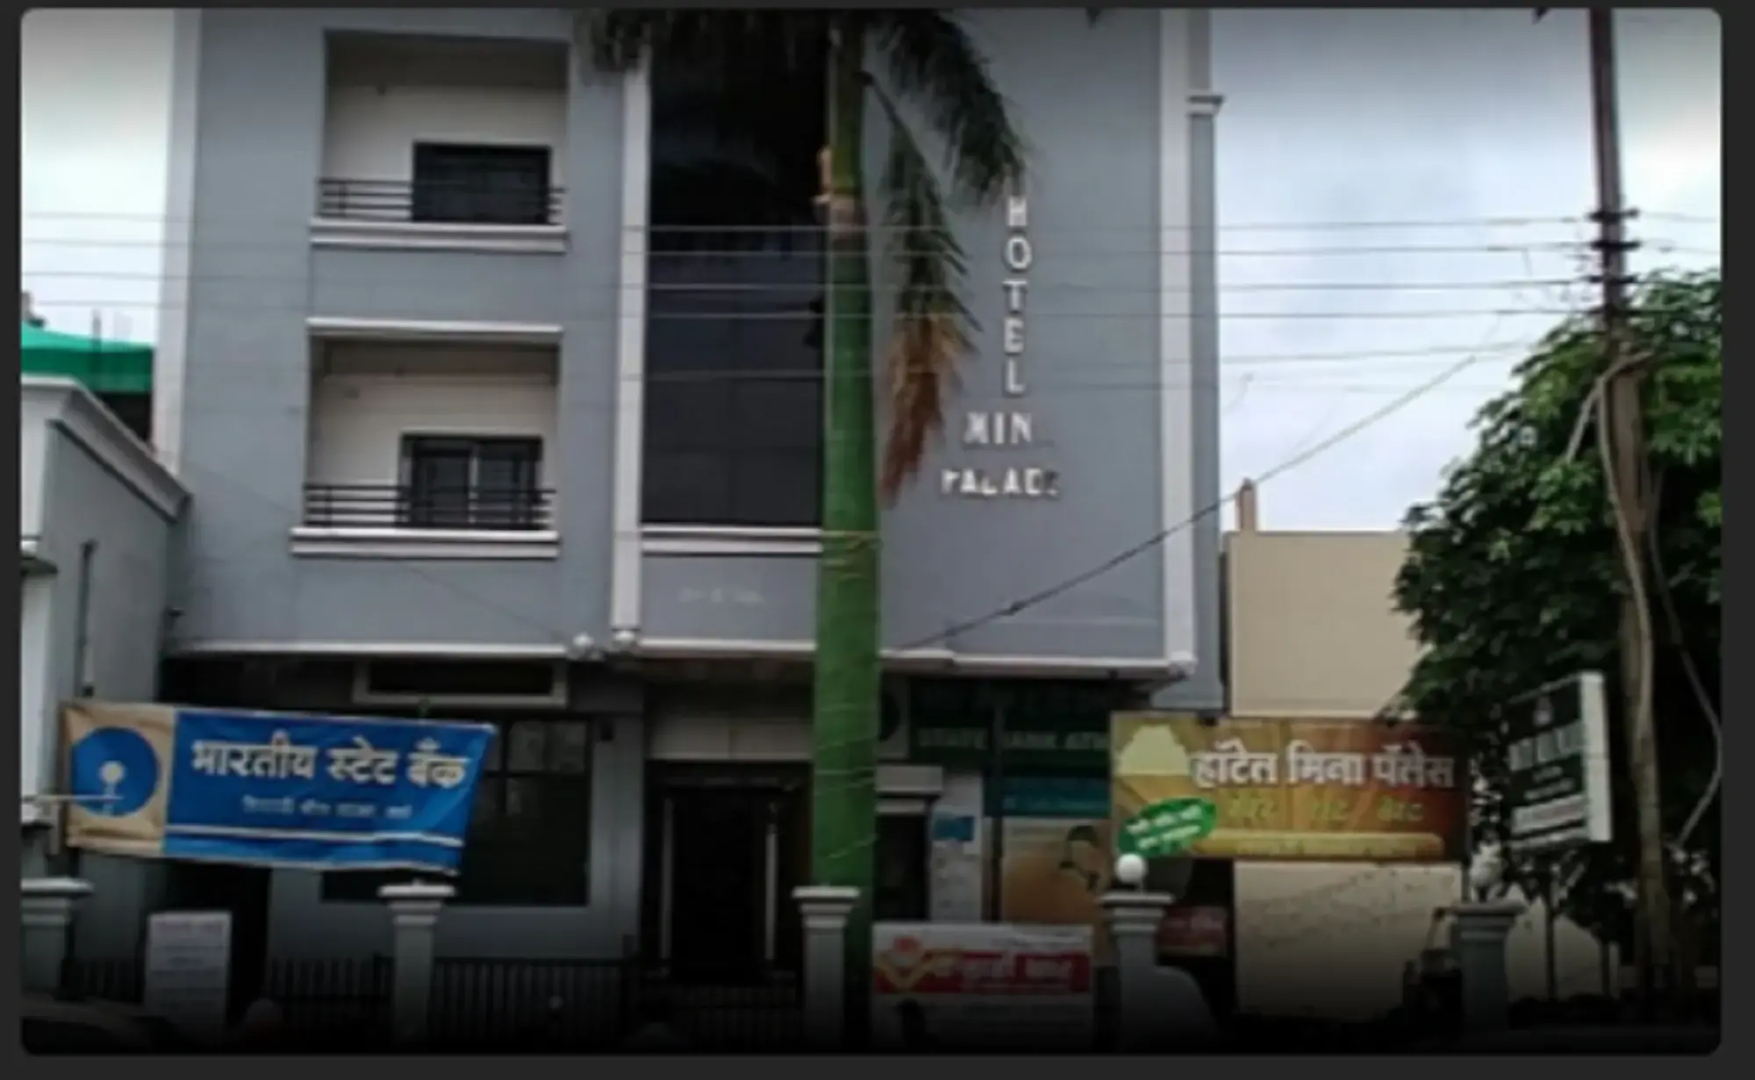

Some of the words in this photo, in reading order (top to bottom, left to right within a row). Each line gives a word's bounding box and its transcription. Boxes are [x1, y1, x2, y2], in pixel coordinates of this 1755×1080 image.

[1002, 196, 1032, 394] HOTEL
[191, 729, 318, 781] भारतीय
[327, 736, 398, 785] स्टेट
